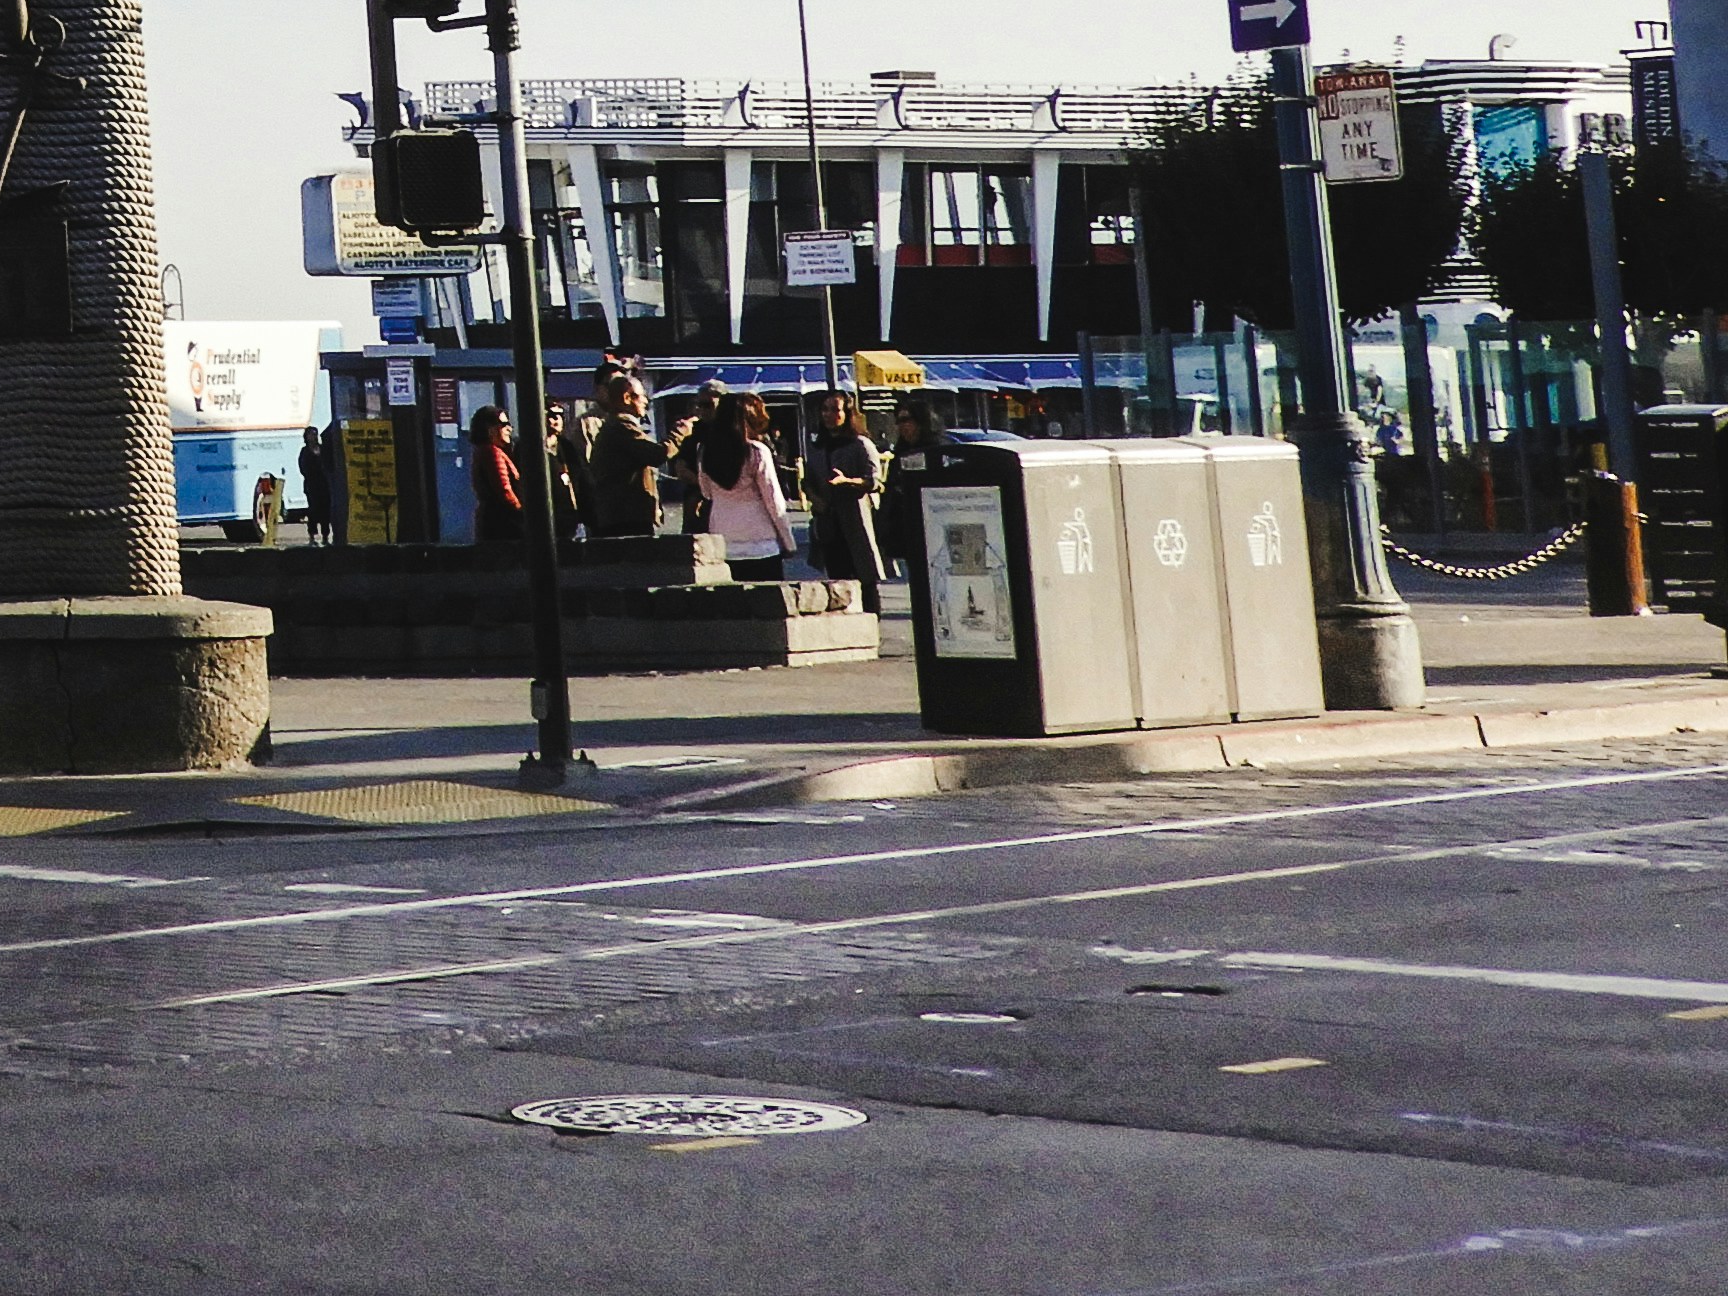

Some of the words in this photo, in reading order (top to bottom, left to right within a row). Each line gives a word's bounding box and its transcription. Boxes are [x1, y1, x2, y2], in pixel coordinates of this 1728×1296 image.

[1319, 74, 1384, 91] TOW-AWAY
[1318, 95, 1336, 117] NO
[1343, 120, 1372, 139] ANY
[1342, 142, 1377, 160] TIME
[206, 348, 261, 366] Prudential
[885, 373, 921, 384] VALET
[208, 390, 242, 411] Supply
